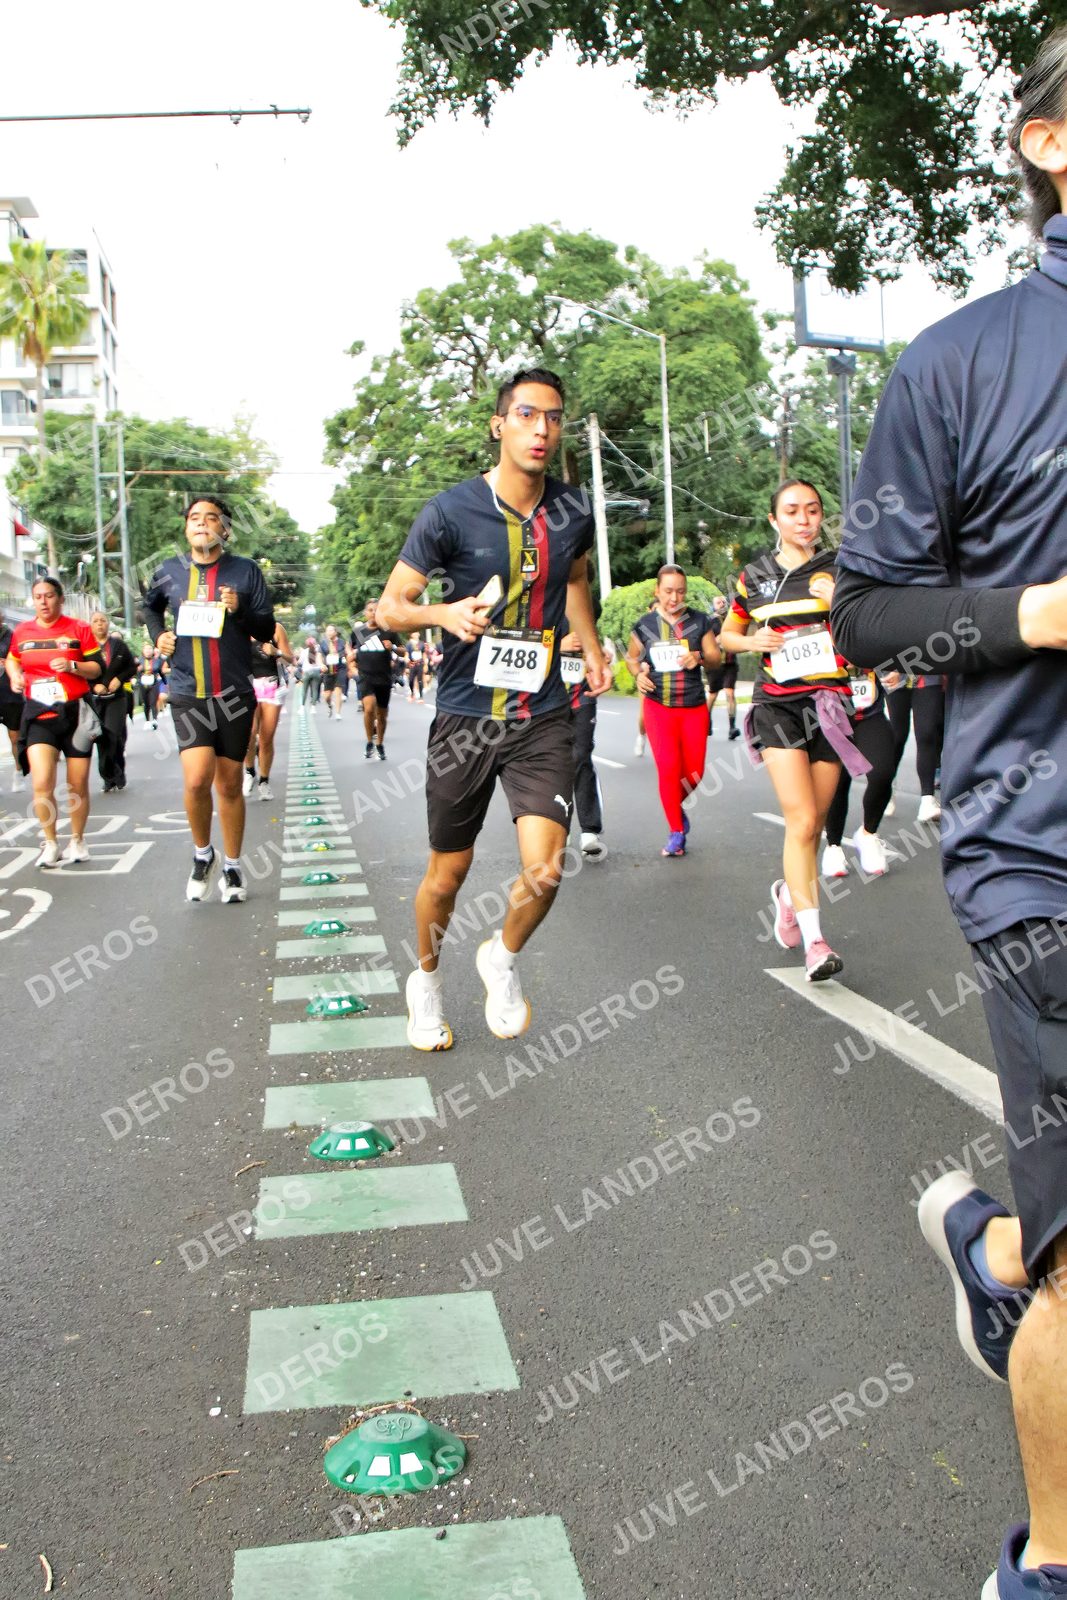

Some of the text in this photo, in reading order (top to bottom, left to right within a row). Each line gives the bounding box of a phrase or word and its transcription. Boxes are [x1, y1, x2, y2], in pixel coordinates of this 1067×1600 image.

[489, 646, 538, 670] 7488
[781, 641, 821, 662] 1083
[562, 660, 581, 672] 180
